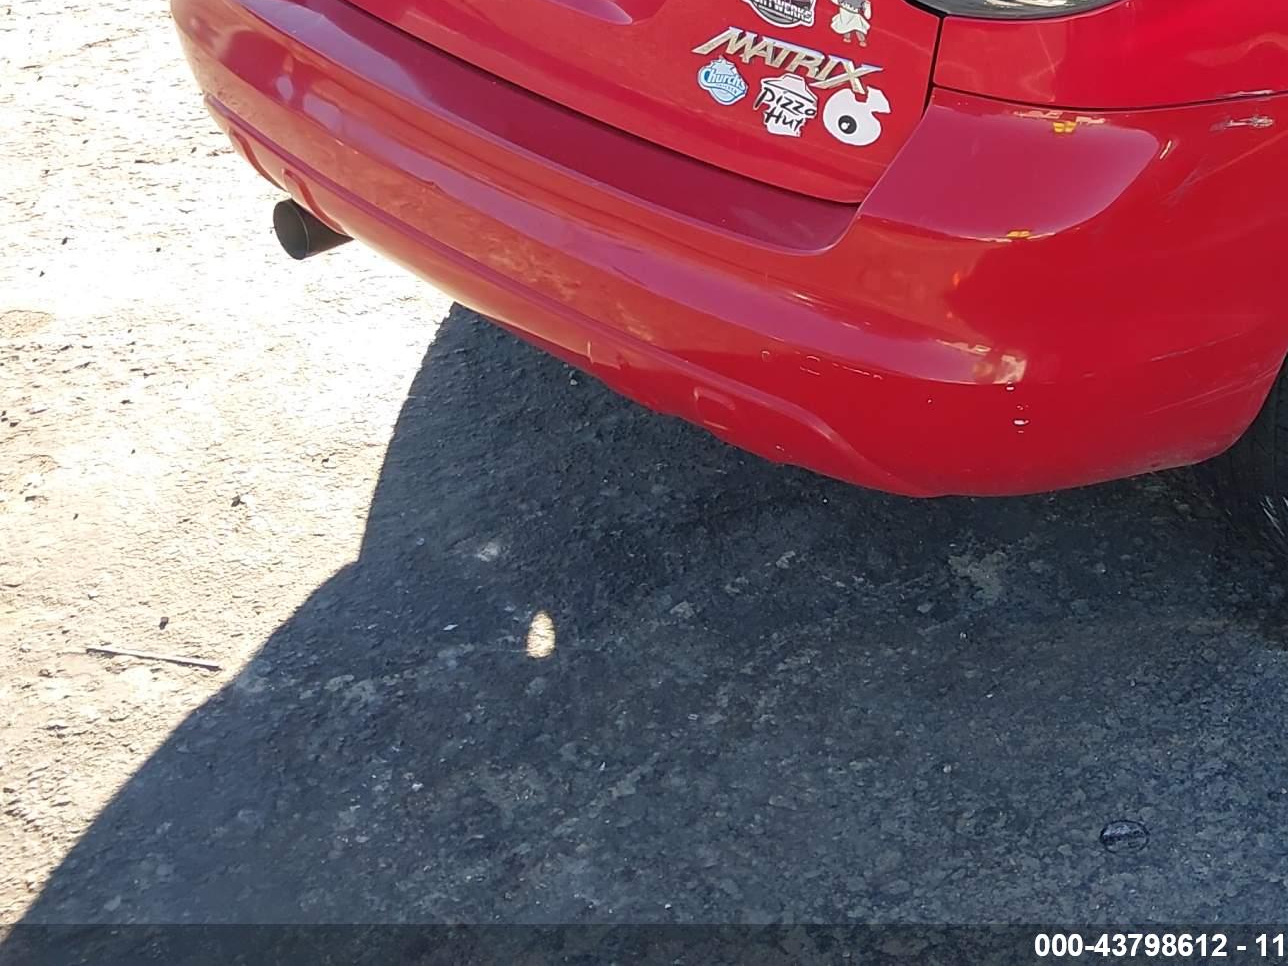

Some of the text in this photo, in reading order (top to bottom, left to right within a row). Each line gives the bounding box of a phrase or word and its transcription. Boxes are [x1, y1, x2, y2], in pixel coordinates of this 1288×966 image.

[691, 26, 884, 94] MATRIX
[753, 87, 818, 117] Pizza
[764, 106, 804, 132] Hut
